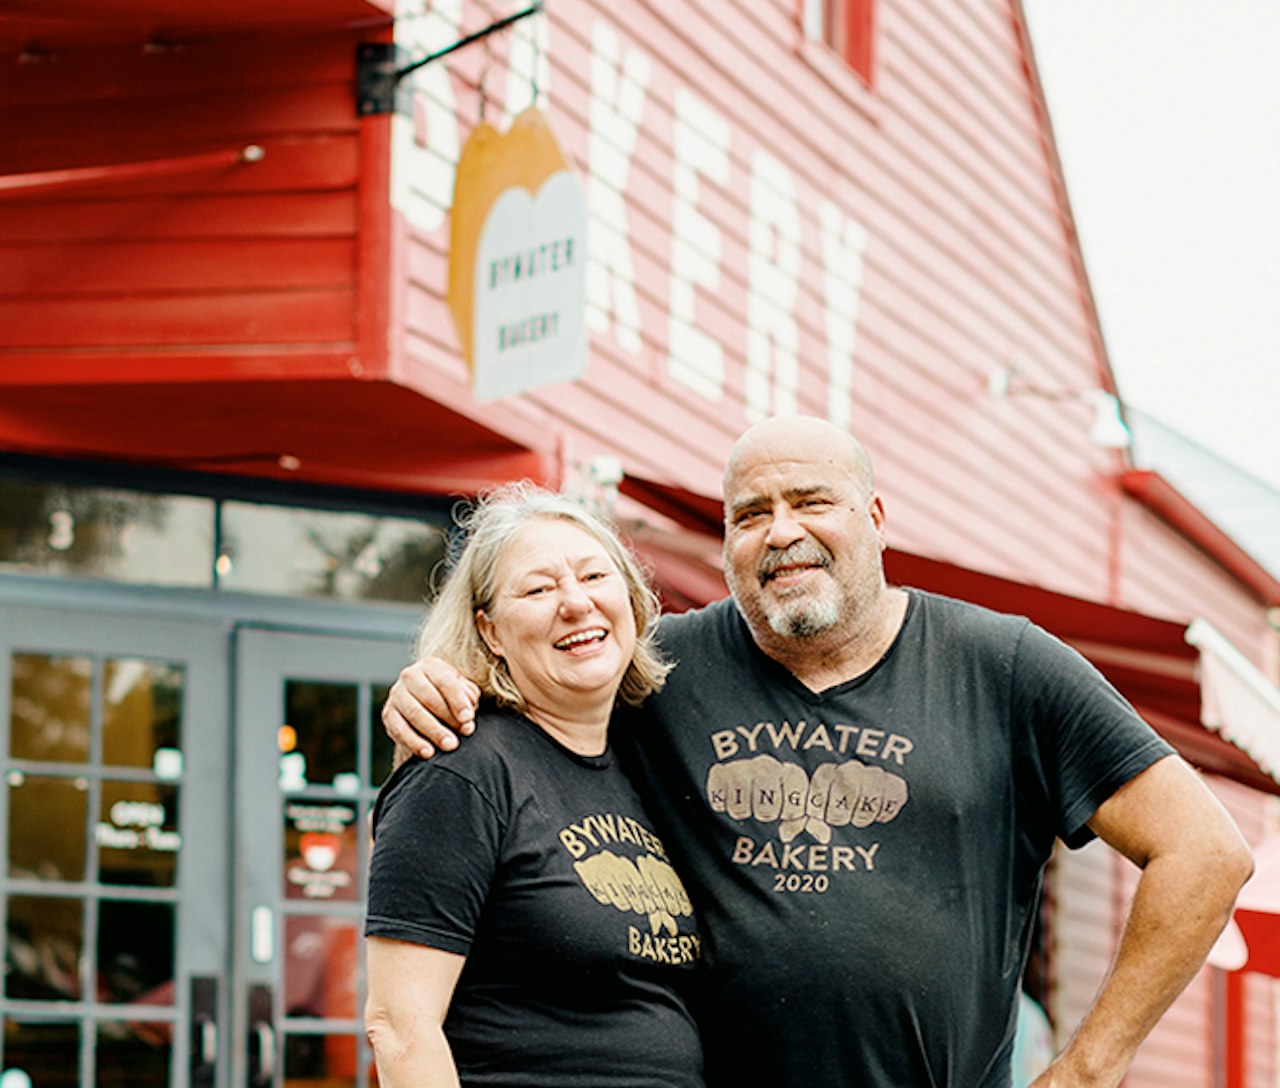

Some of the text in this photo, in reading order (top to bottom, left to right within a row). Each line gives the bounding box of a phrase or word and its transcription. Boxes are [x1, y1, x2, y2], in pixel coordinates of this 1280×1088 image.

[489, 237, 576, 289] BYWATER
[499, 312, 559, 352] BAKERY
[709, 721, 914, 765] BYWATER
[559, 813, 671, 863] BYWATER
[732, 836, 879, 872] BAKERY
[773, 873, 829, 893] 2020
[628, 925, 701, 965] BAKERY
